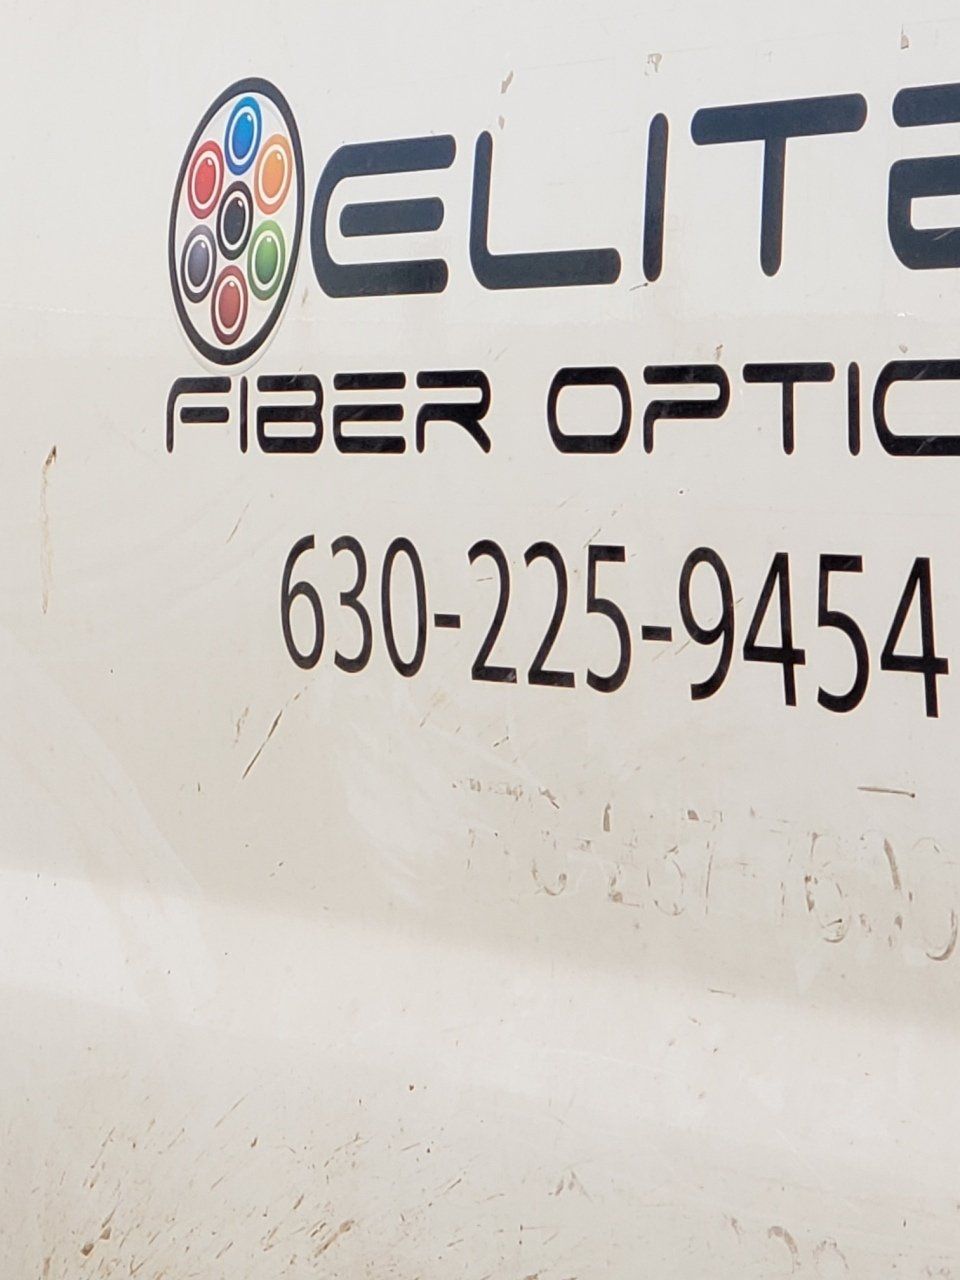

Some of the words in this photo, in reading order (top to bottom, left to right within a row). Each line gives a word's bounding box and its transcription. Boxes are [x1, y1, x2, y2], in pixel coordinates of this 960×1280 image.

[165, 368, 492, 454] FIBER
[546, 359, 960, 457] OPTIC
[280, 534, 949, 719] 630-225-9454
